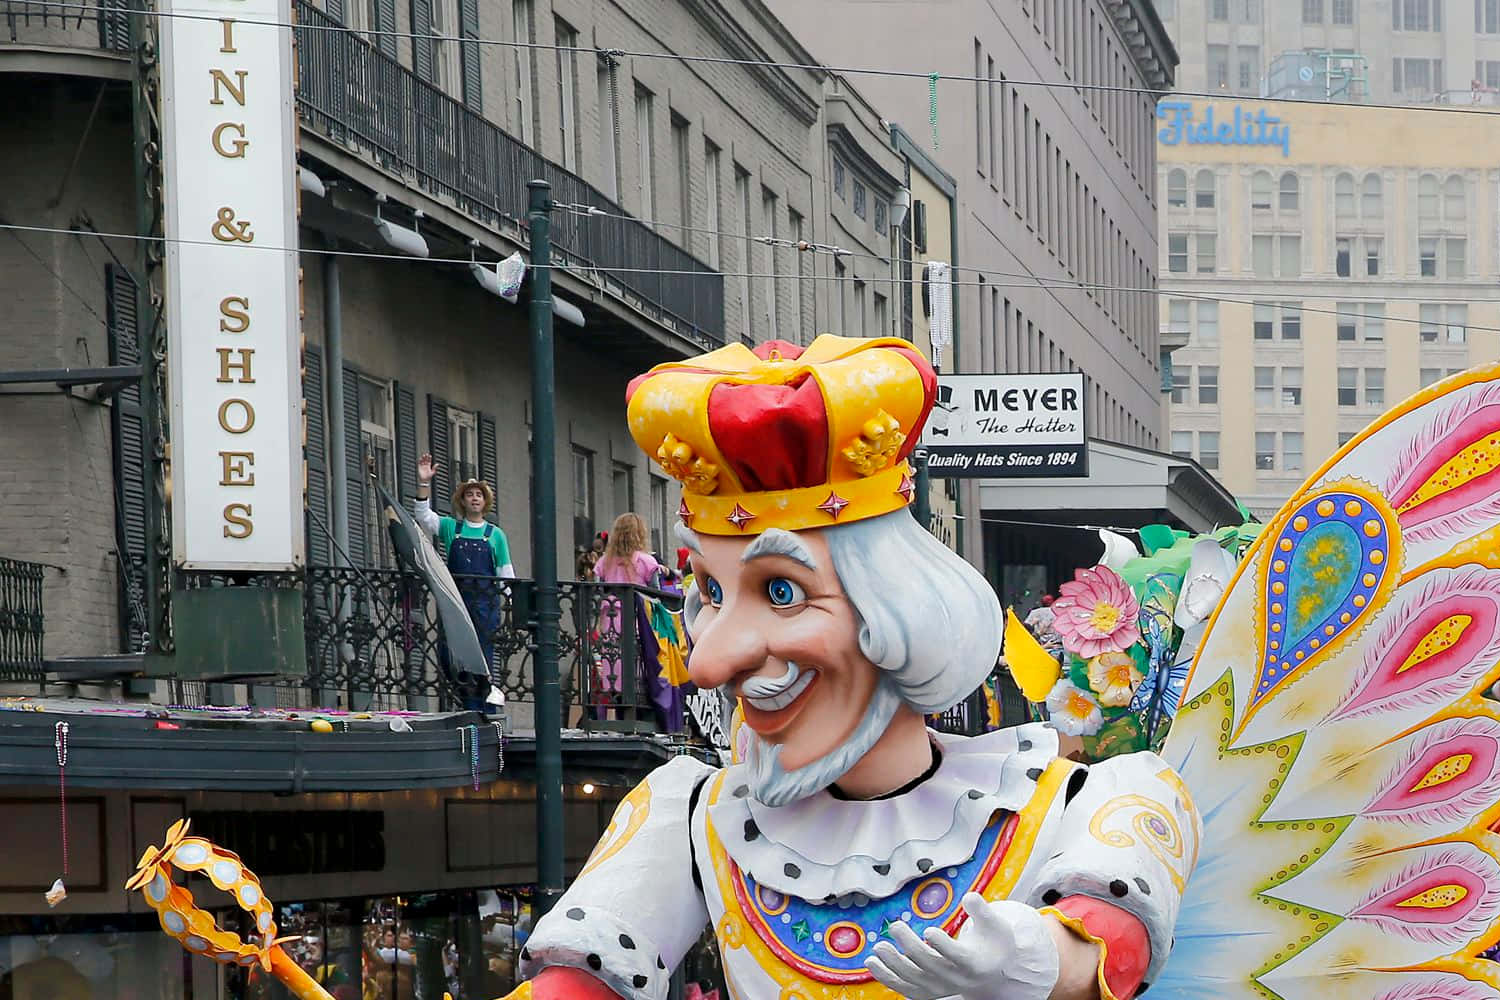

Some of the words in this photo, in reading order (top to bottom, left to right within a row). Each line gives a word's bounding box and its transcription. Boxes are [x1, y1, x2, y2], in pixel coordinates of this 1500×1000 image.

[209, 0, 250, 159] ING
[1156, 101, 1290, 158] Fidelity
[211, 206, 254, 243] &
[215, 296, 256, 539] SHOES
[974, 388, 1078, 412] MEYER
[975, 416, 1009, 434] The
[1014, 416, 1077, 434] Hatter
[927, 453, 972, 469] Quality
[974, 452, 1004, 467] Hats
[1006, 452, 1043, 467] Since
[1046, 451, 1078, 466] 1894
